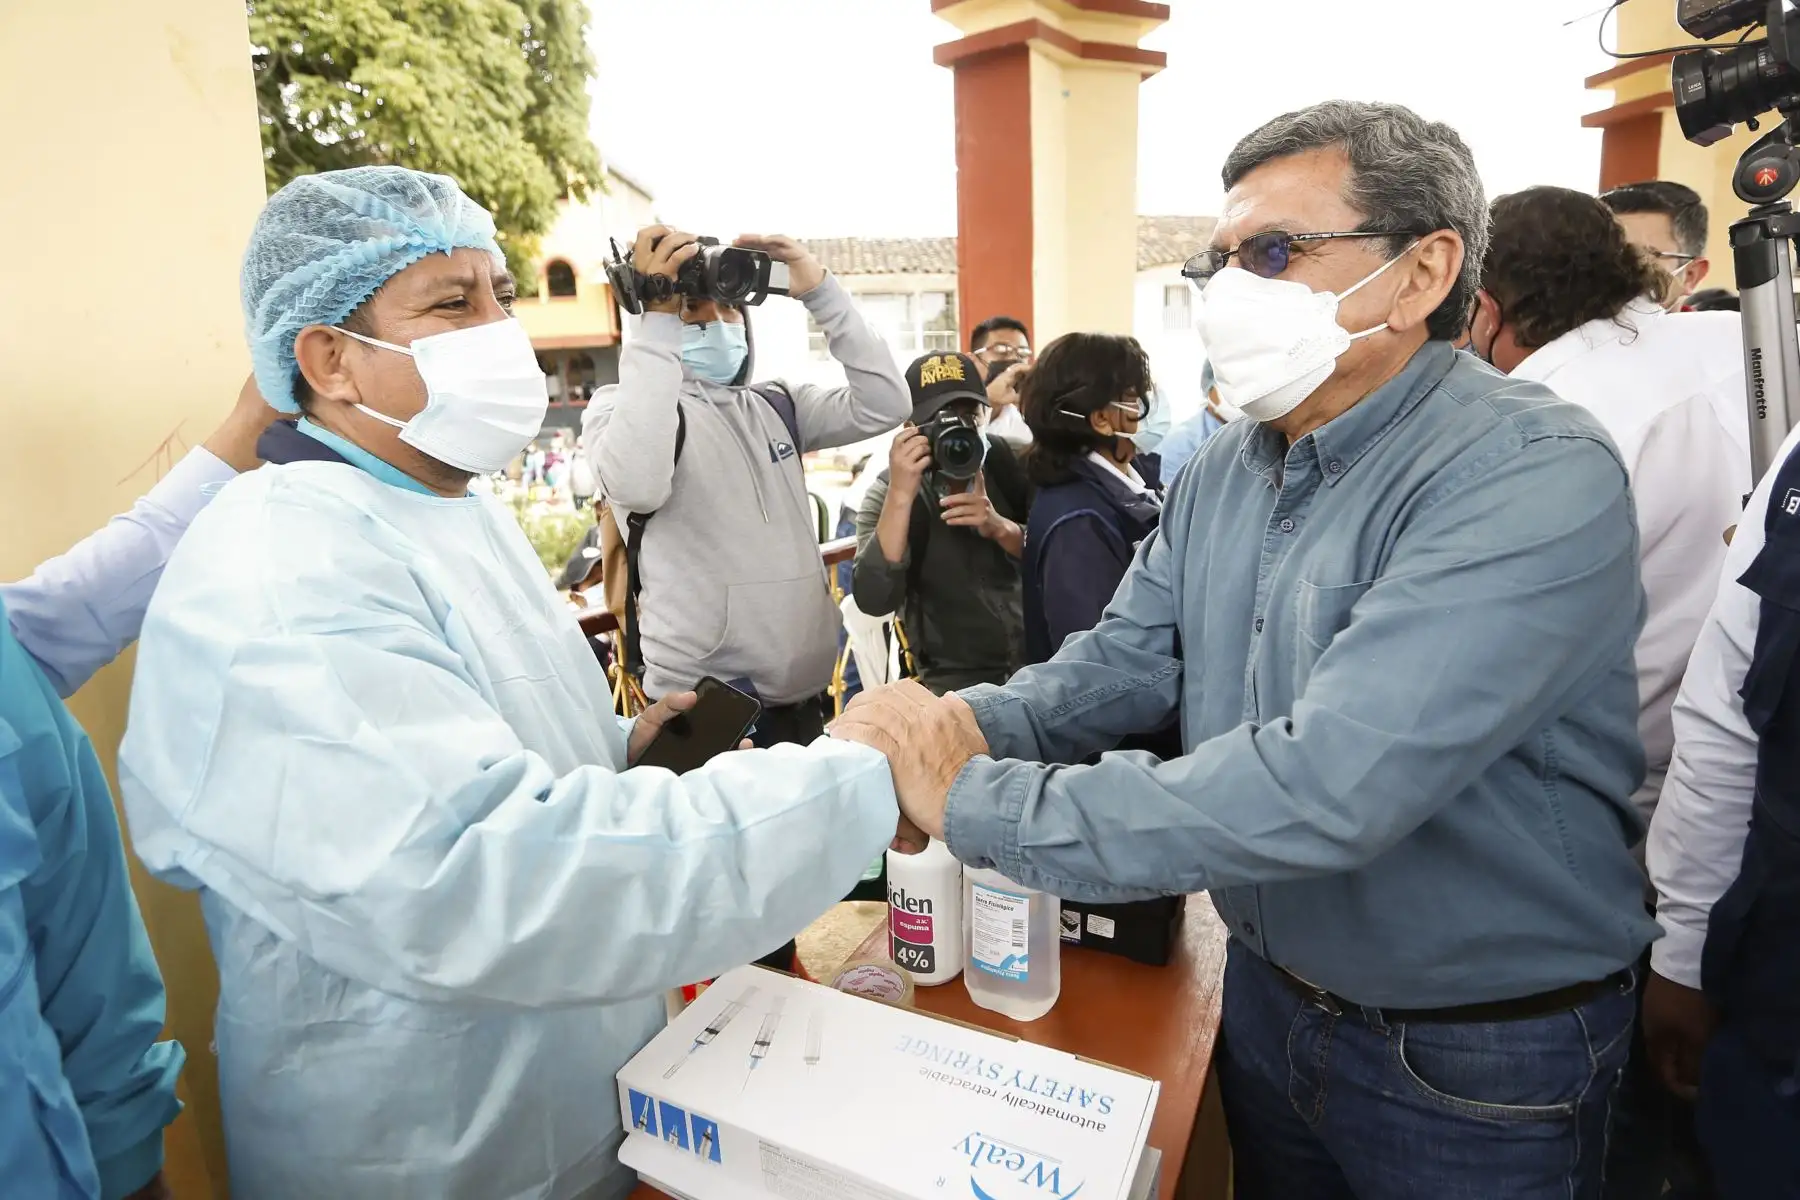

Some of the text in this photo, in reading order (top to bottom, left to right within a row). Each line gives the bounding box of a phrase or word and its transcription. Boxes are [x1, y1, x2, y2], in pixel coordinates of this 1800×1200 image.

[1751, 347, 1767, 420] Manfrotto
[897, 946, 930, 969] 4%
[899, 920, 930, 931] espuma
[893, 1034, 1115, 1115] SAFETY SYRINGE
[919, 1066, 1107, 1133] automatically retractable
[952, 1131, 1062, 1197] Wealy
